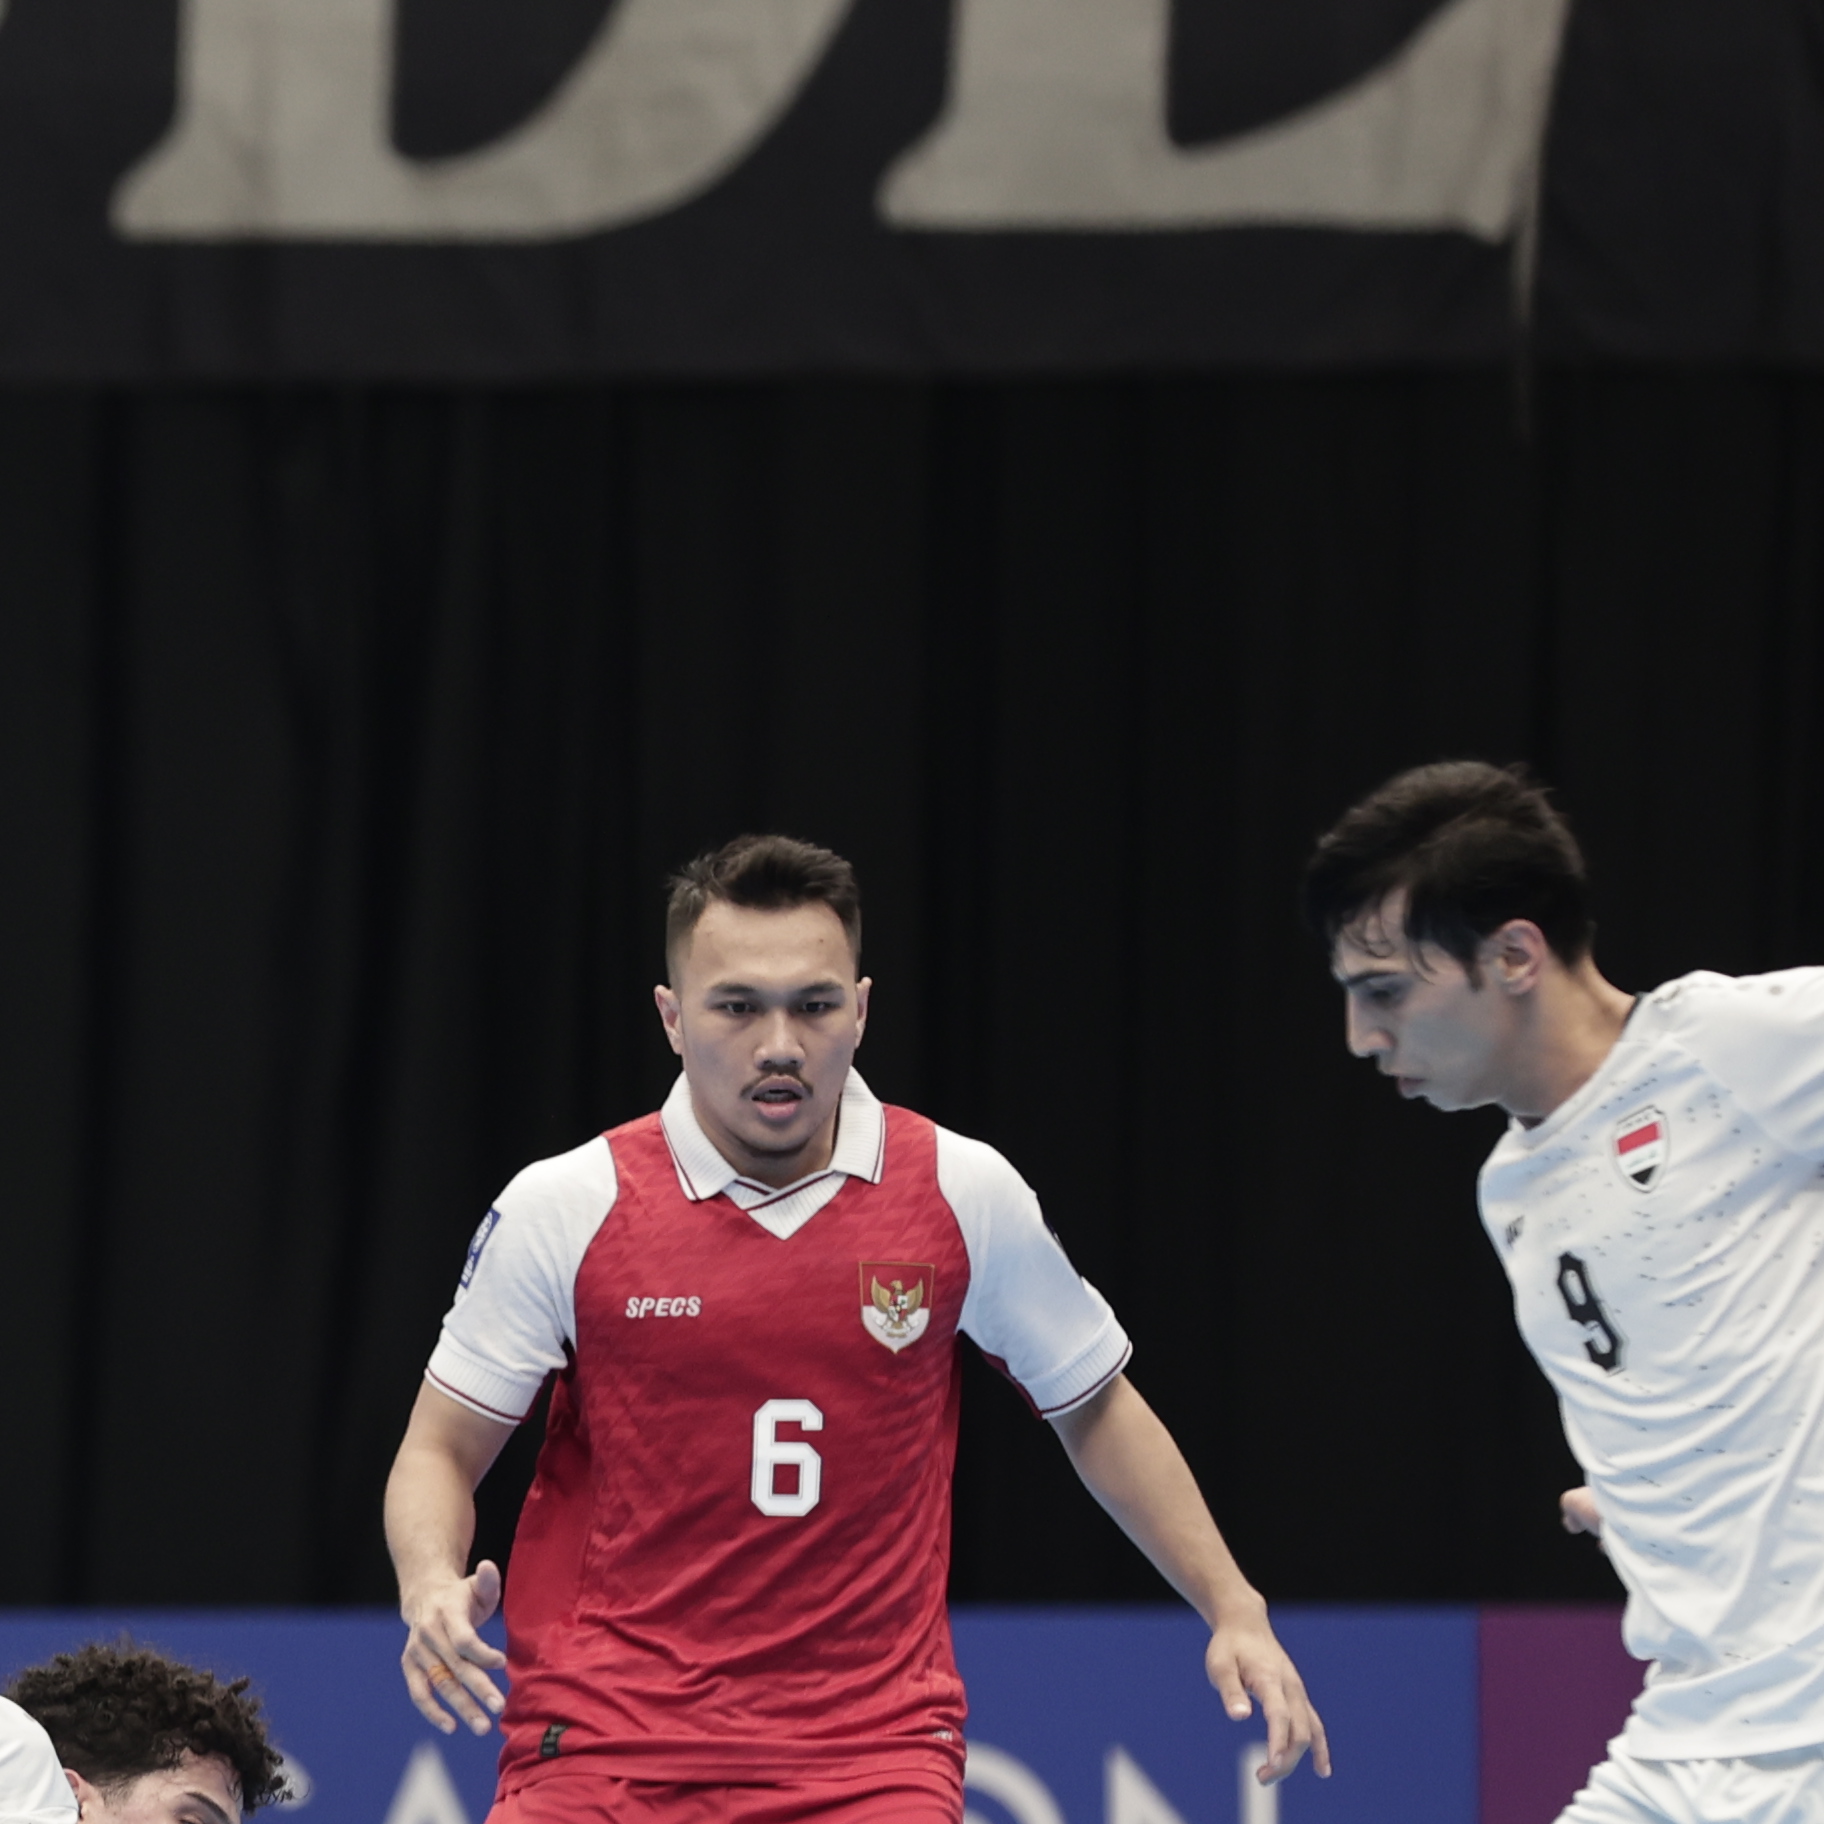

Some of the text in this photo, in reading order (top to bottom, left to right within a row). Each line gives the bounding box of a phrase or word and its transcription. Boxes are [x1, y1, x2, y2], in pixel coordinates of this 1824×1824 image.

[625, 1296, 702, 1318] SPECS
[1557, 1251, 1628, 1375] 9
[752, 1399, 823, 1516] 6
